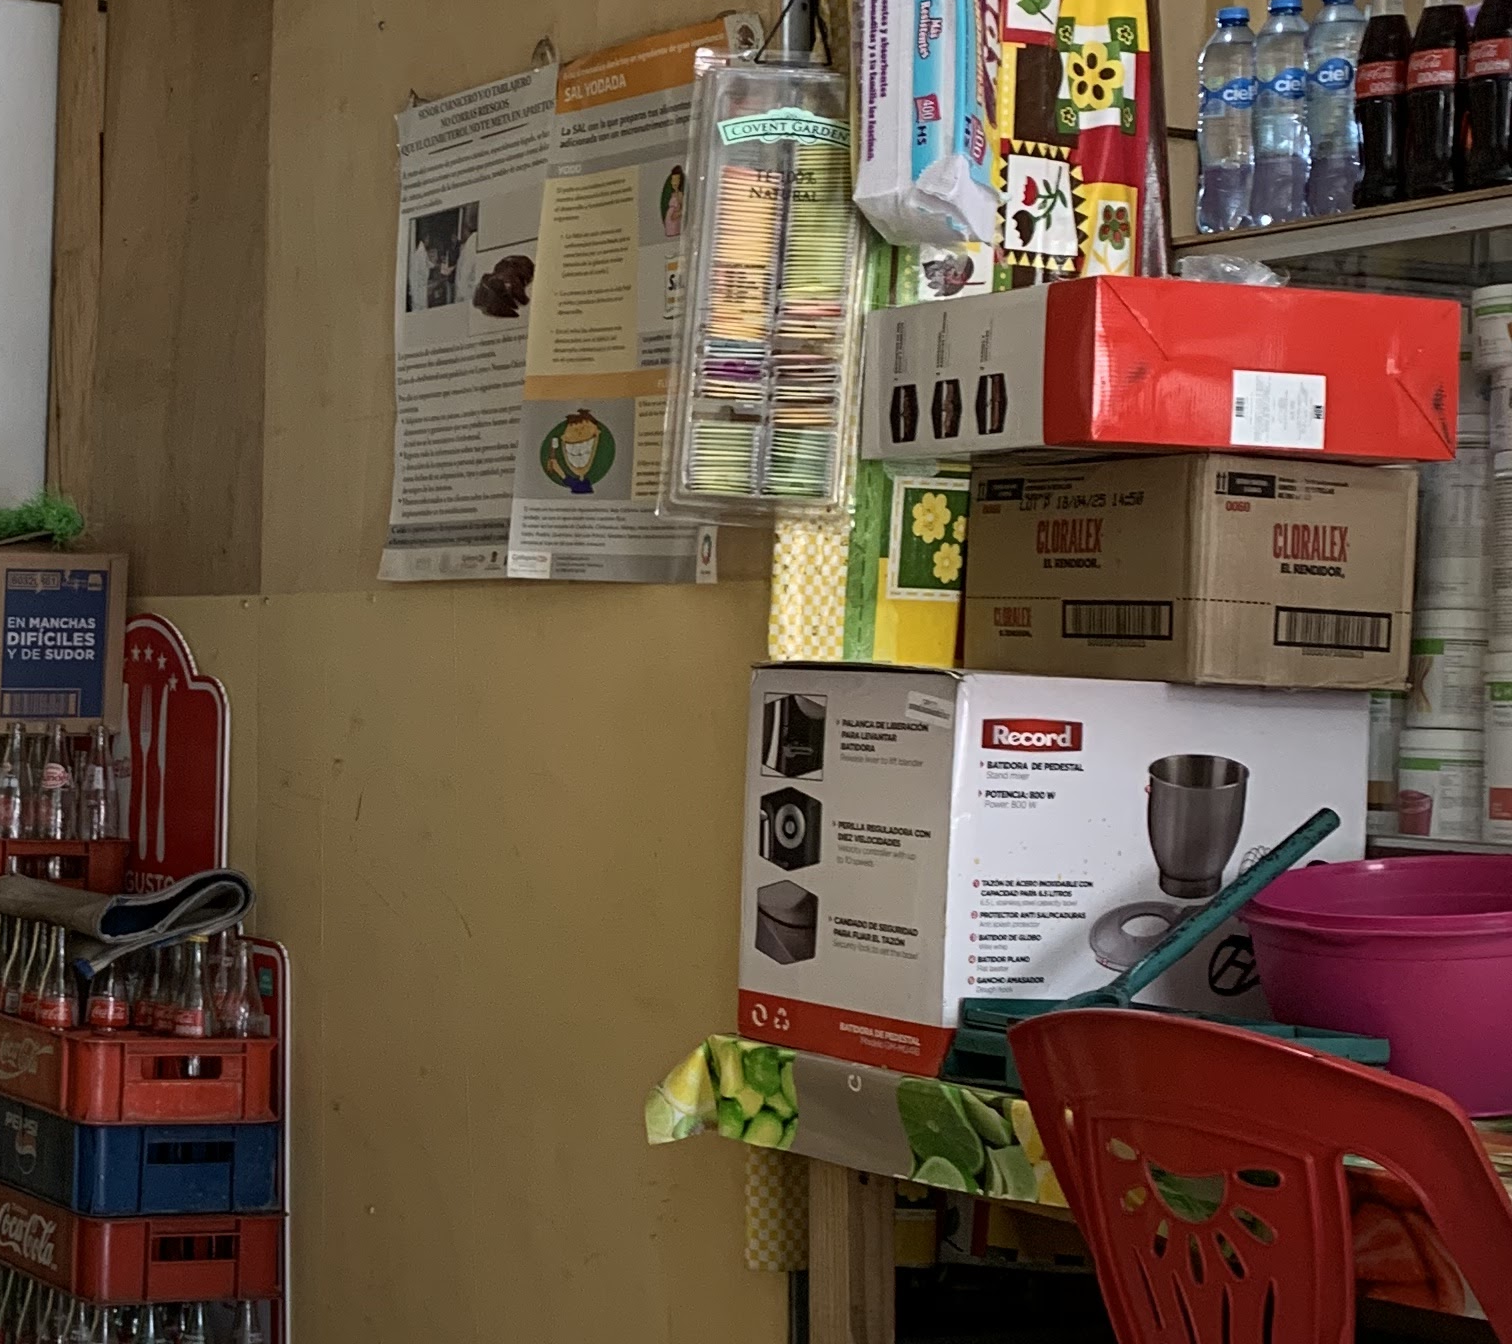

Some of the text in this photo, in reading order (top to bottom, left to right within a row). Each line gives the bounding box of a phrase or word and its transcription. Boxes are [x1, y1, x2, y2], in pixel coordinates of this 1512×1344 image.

[1317, 64, 1349, 83] ciel
[1223, 85, 1254, 101] ciel
[1275, 79, 1306, 93] ciel
[921, 99, 935, 120] 400
[731, 121, 848, 142] COVENT GARDEN
[1036, 518, 1104, 555] CLORALEX
[1273, 522, 1349, 563] CLORALEX
[7, 617, 96, 630] EN MANCHAS
[6, 628, 96, 647] DIFÍCILES
[7, 649, 96, 661] Y DE SUDOR
[992, 724, 1073, 748] Record
